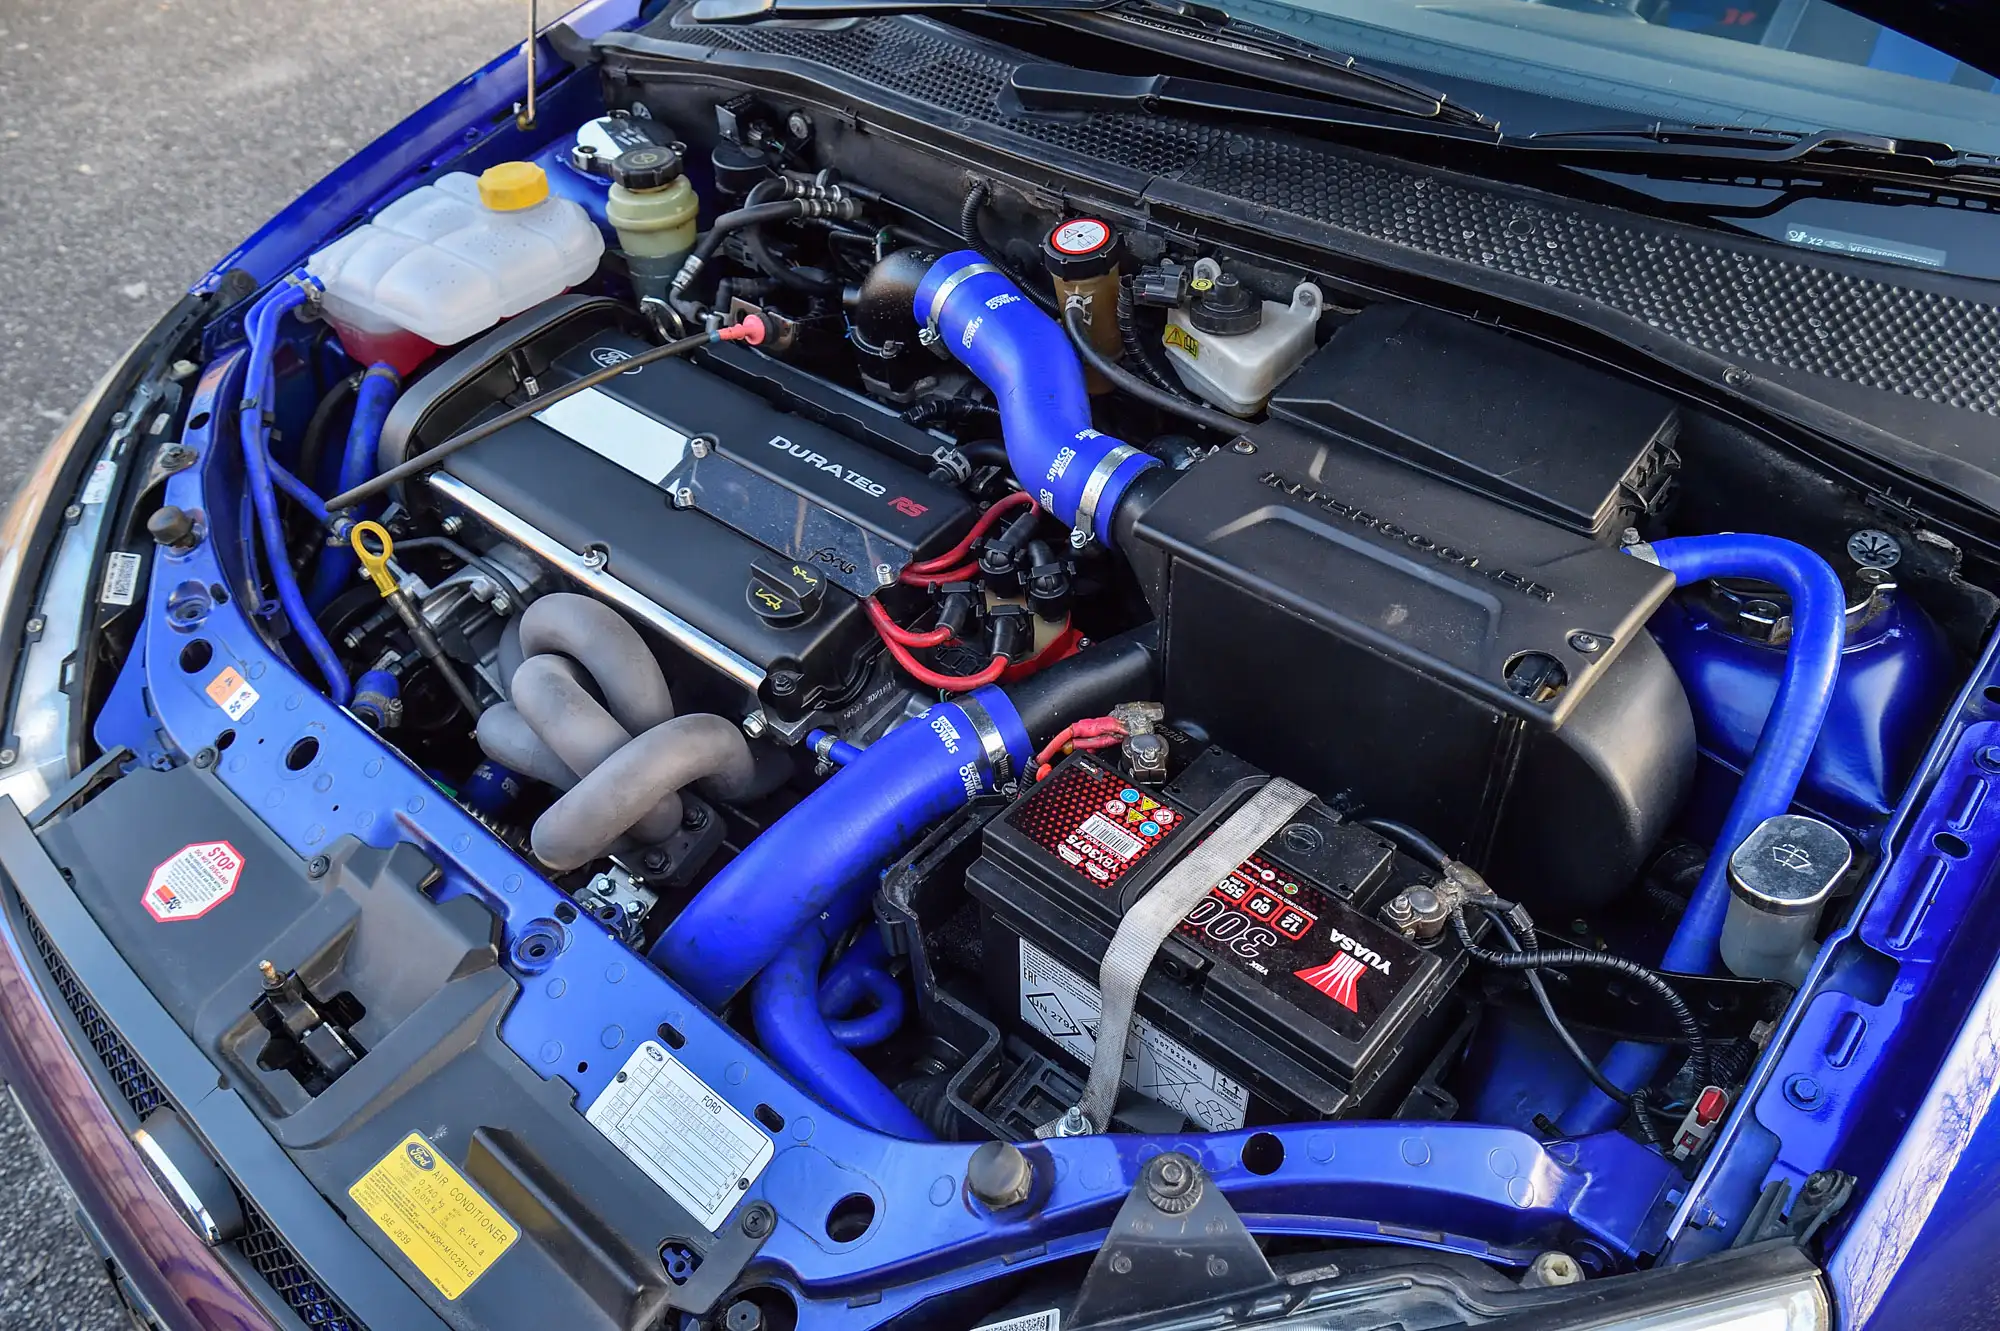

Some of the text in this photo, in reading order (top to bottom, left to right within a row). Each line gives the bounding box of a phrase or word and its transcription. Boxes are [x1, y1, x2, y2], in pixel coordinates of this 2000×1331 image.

[768, 435, 929, 518] DURATEC RS
[1046, 446, 1070, 483] SAMCO
[1257, 471, 1556, 604] INTERCOOLER
[808, 547, 857, 574] Focus
[930, 720, 959, 754] SAMCO
[208, 847, 235, 871] STOP
[1065, 834, 1120, 872] YBX3075
[1217, 877, 1246, 900] 550
[1248, 896, 1271, 916] 60
[1288, 911, 1304, 923] VOLT
[1184, 896, 1277, 958] 300
[1280, 915, 1300, 934] 12
[1329, 928, 1391, 976] YUASA
[702, 1095, 722, 1115] FORD
[410, 1148, 431, 1168] Ford
[432, 1170, 449, 1186] AIR
[449, 1187, 508, 1244] CONDITIONER
[380, 1213, 412, 1246] SAE J639
[458, 1227, 478, 1250] R-134
[430, 1231, 475, 1278] WSH-M1C231-B
